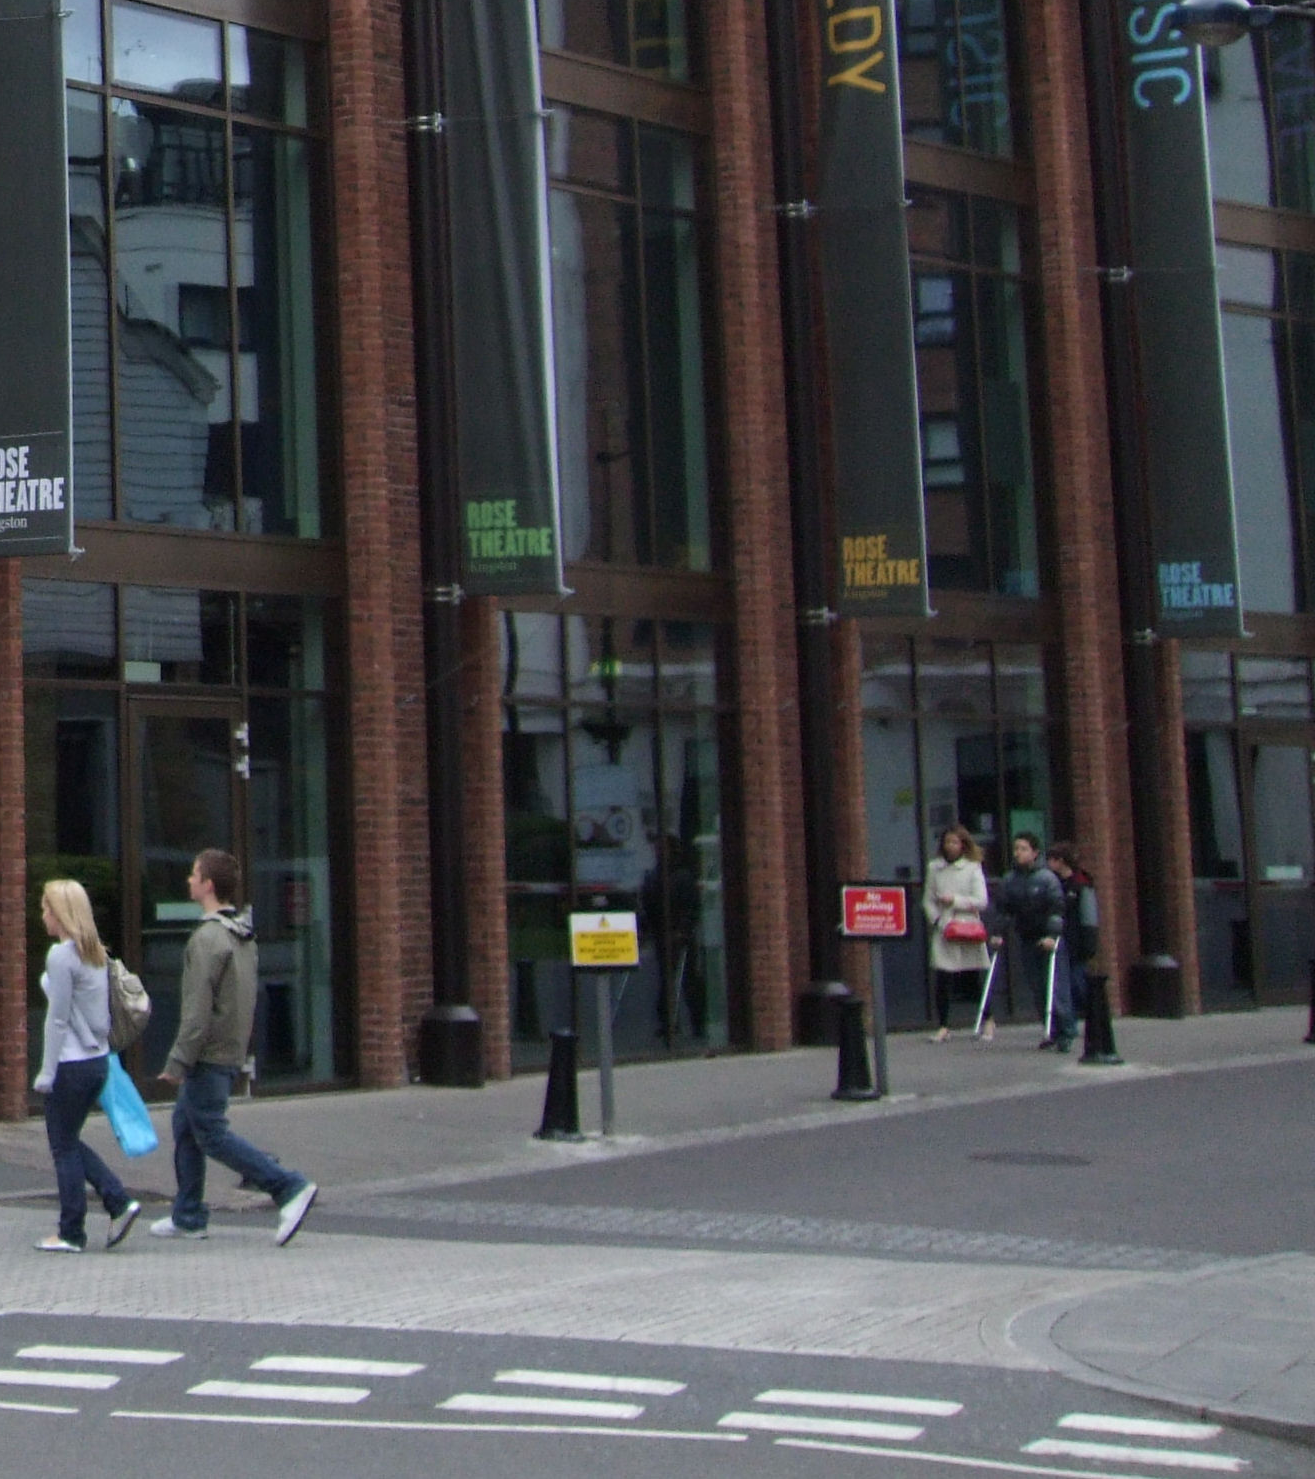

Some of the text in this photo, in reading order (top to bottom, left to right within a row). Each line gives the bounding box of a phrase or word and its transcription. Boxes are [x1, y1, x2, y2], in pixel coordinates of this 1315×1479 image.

[467, 499, 517, 528] ROSE
[468, 527, 552, 558] THEATRE
[843, 534, 888, 561] ROSE
[844, 559, 920, 587] THEATRE
[1158, 562, 1201, 584] ROSE
[1161, 583, 1235, 607] THEATRE
